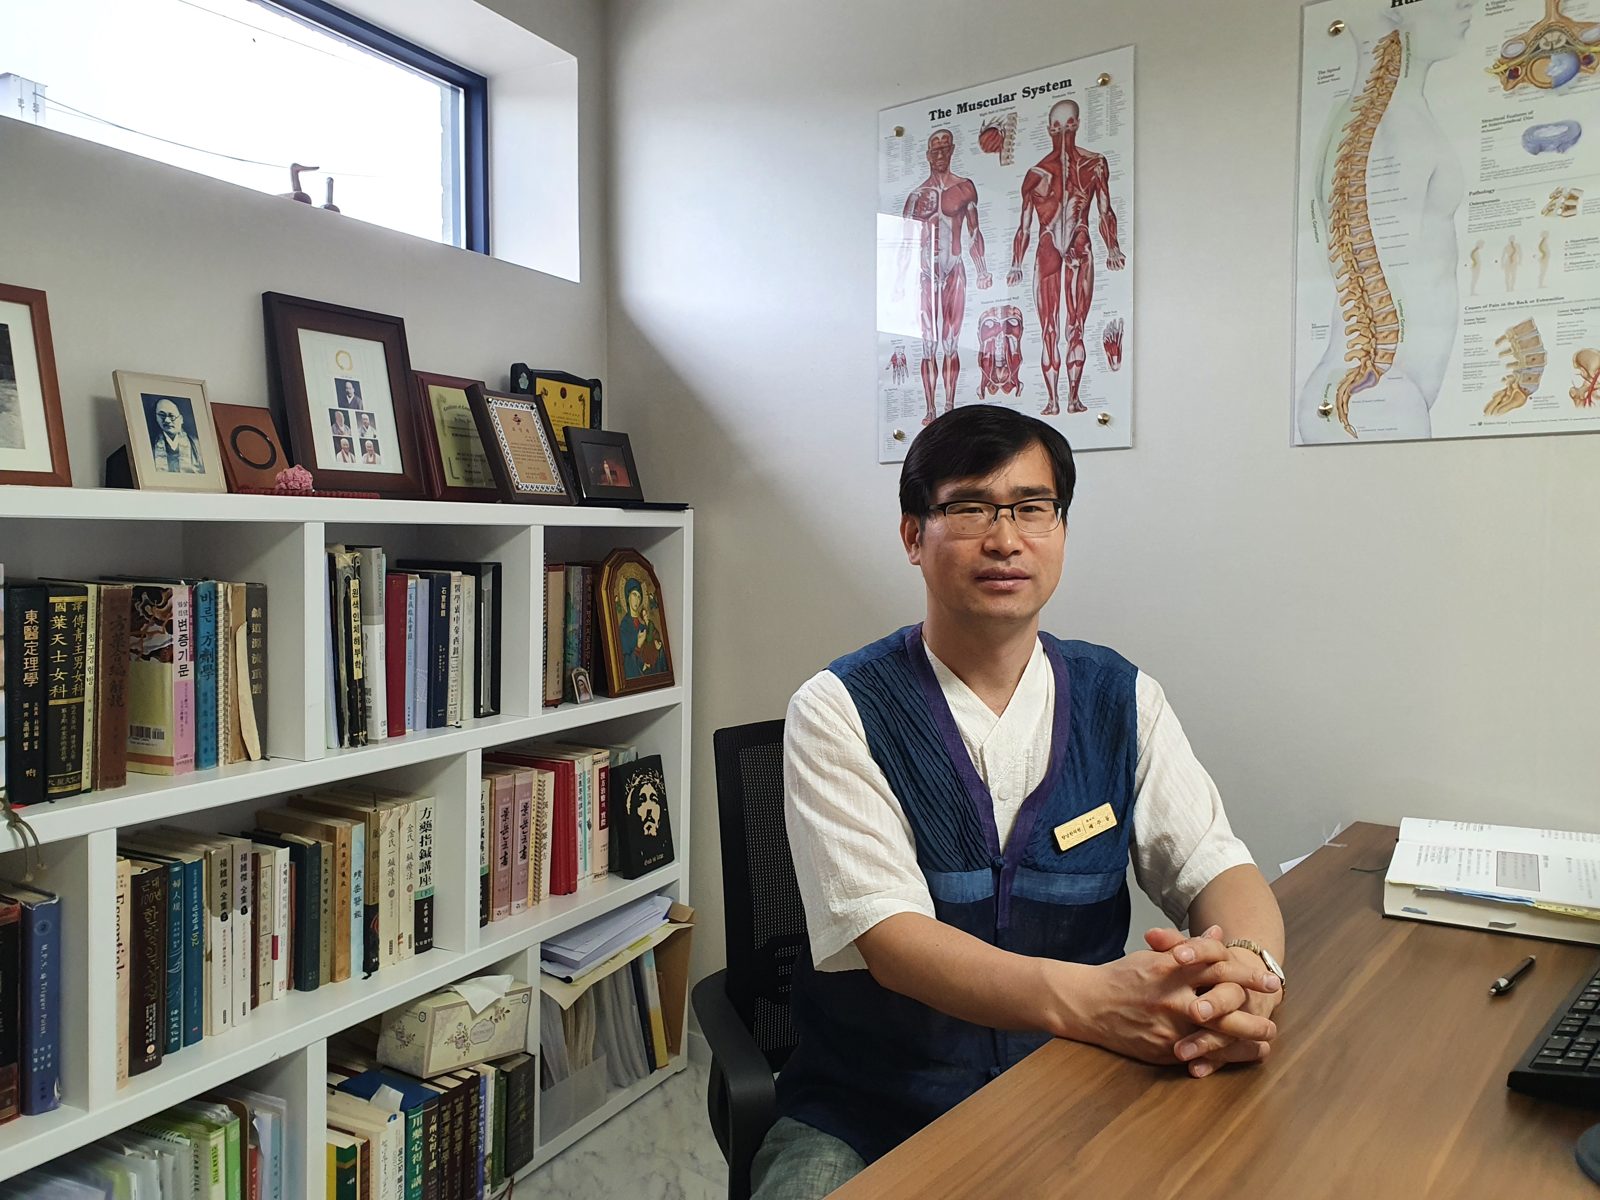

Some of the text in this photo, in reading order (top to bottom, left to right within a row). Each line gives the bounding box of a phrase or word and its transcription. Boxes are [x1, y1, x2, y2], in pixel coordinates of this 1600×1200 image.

[928, 77, 1072, 122] The Muscular System
[23, 609, 39, 688] 東醫定理學
[178, 618, 190, 678] 변증기문
